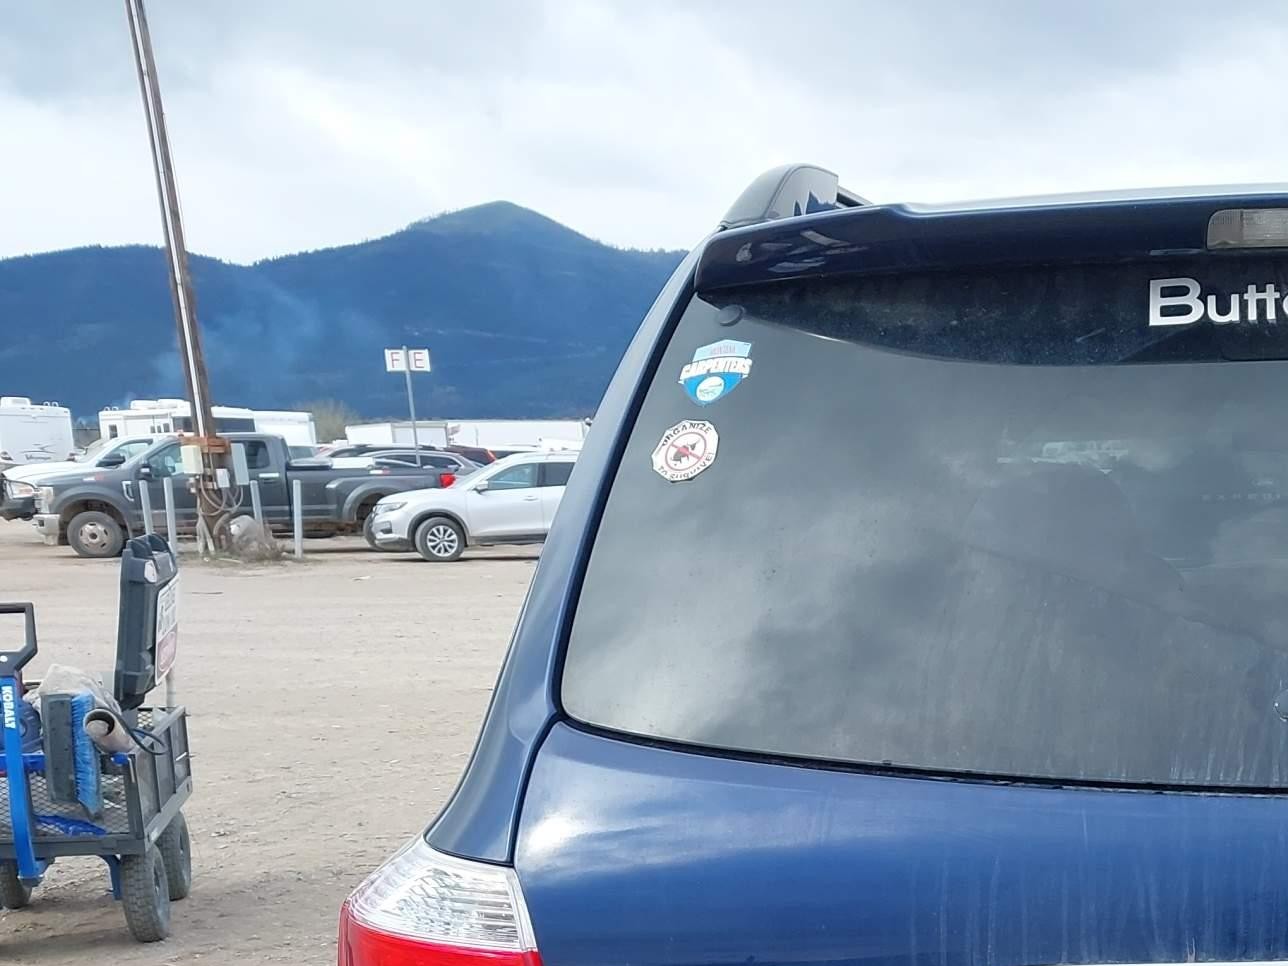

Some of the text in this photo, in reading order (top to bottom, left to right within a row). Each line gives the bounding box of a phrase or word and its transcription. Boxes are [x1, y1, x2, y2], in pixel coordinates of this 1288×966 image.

[390, 351, 425, 369] F E
[661, 422, 712, 447] ORGANIZE
[1, 685, 16, 729] KOBALT
